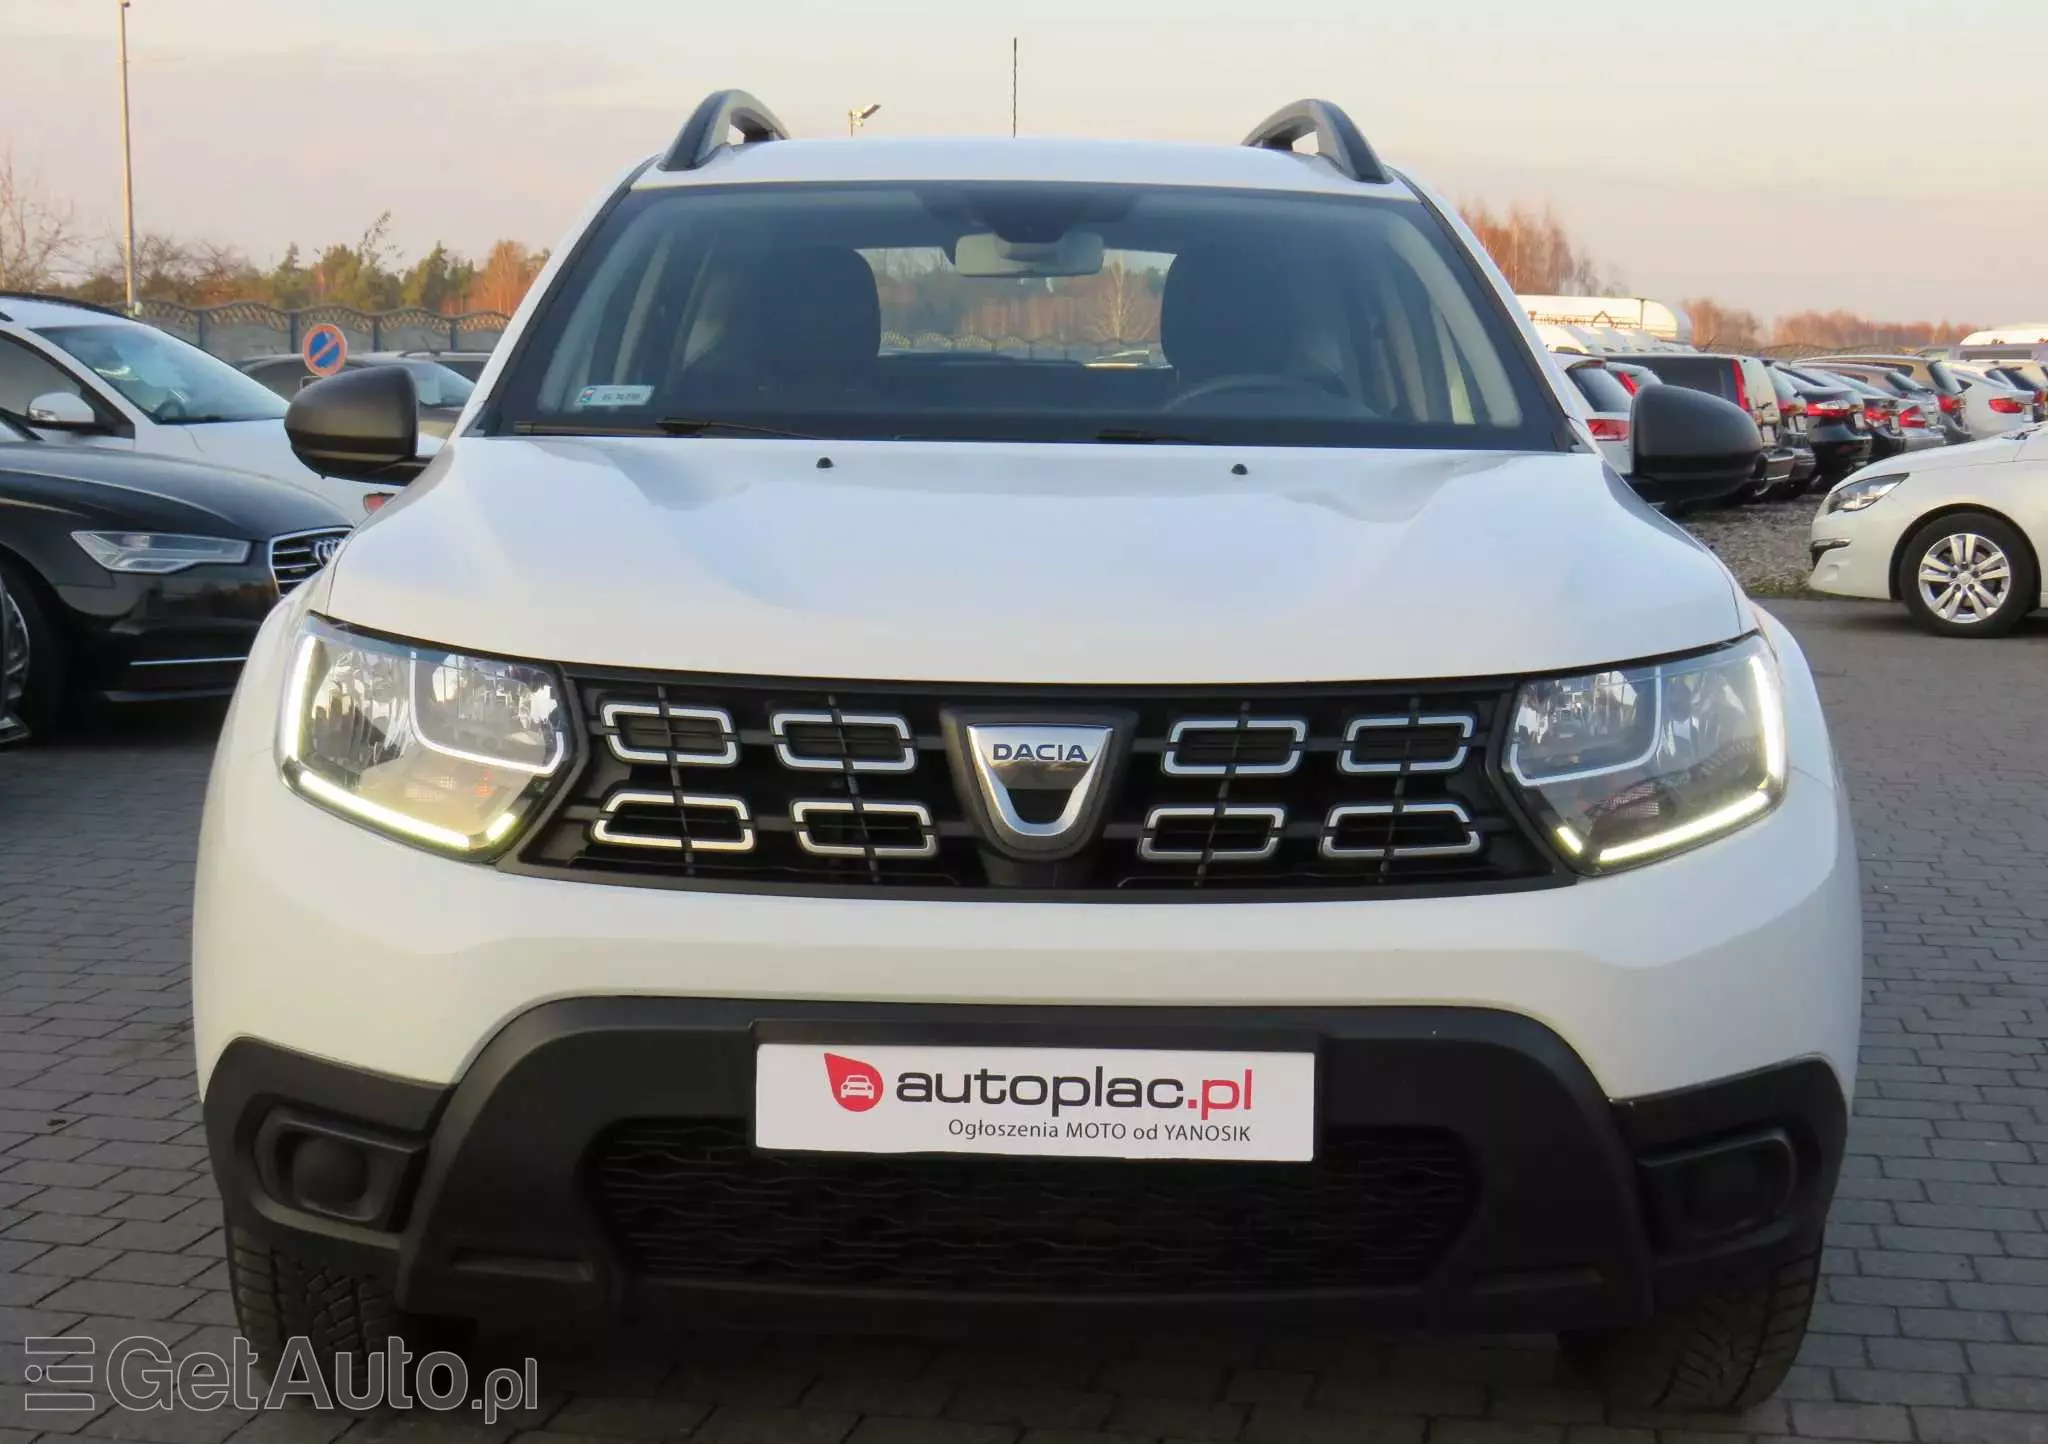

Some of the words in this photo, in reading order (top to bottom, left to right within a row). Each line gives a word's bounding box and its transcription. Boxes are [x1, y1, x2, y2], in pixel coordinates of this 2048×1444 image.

[993, 743, 1088, 761] DACIA
[896, 1066, 1252, 1120] autoplac.pl
[948, 1119, 1059, 1140] Ogłoszenia
[1066, 1122, 1127, 1140] MOTO
[1133, 1124, 1158, 1141] od
[1165, 1125, 1251, 1142] YANOSIK
